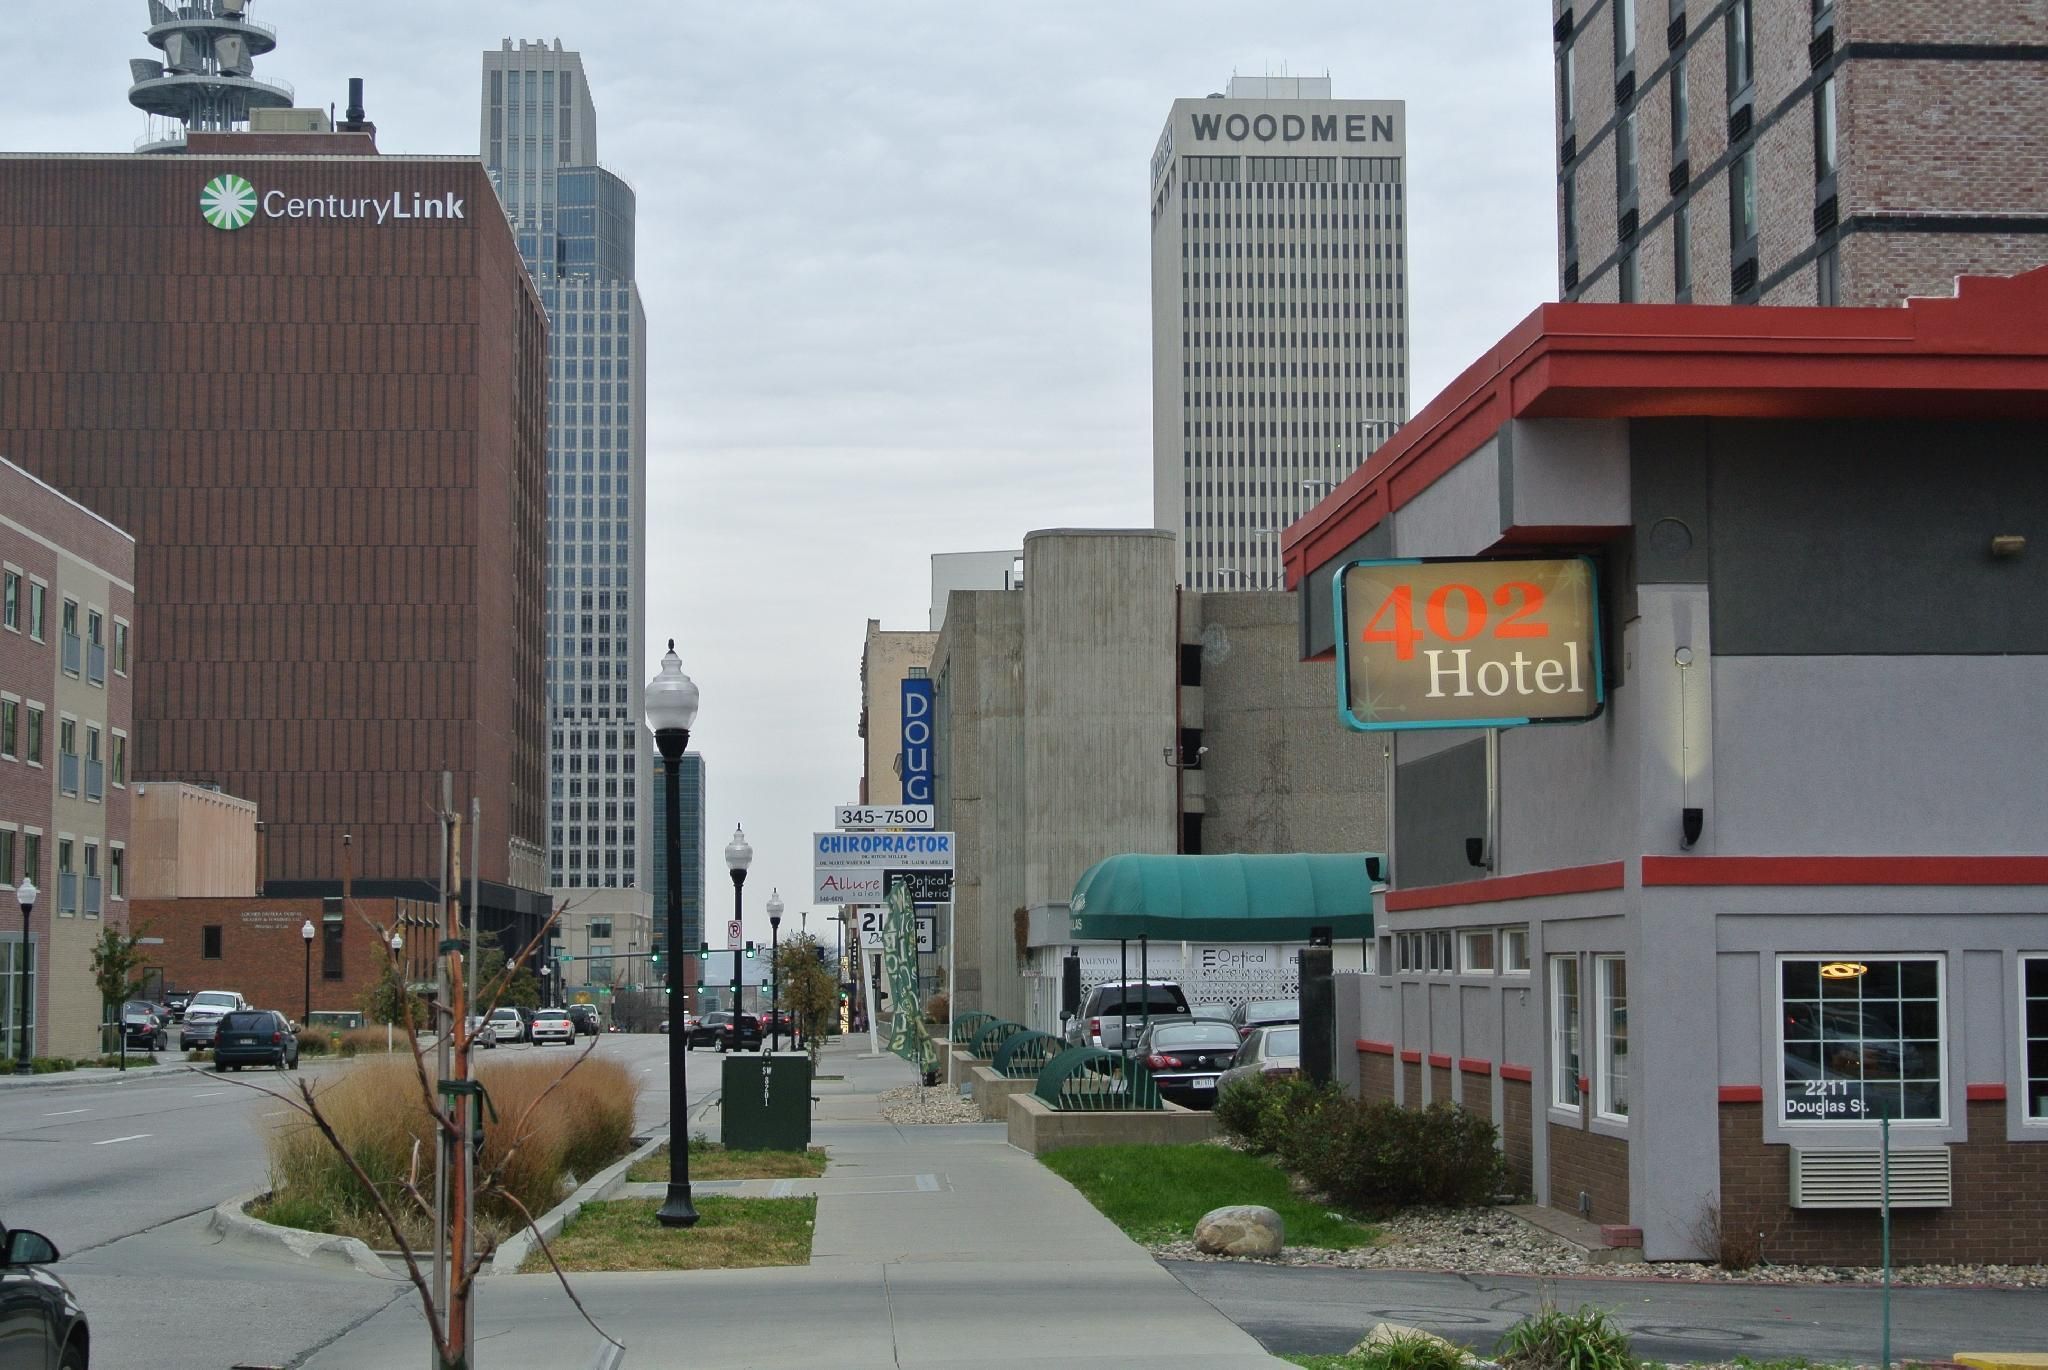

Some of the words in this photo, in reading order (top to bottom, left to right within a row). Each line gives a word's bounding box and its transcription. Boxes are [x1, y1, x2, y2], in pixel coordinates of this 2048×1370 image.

[1191, 113, 1394, 142] WOODMEN
[263, 190, 465, 225] CenturyLink
[1361, 581, 1549, 661] 402
[1424, 641, 1584, 698] Hotel
[905, 692, 930, 800] DOUG
[841, 809, 928, 824] 345-7500
[819, 835, 949, 853] CHIROPRACTOR
[906, 874, 947, 887] Optical
[910, 885, 949, 898] alleria
[1218, 948, 1267, 967] Optical
[1805, 1079, 1848, 1097] 2211
[1786, 1098, 1846, 1115] Douglas
[1850, 1098, 1870, 1113] St.
